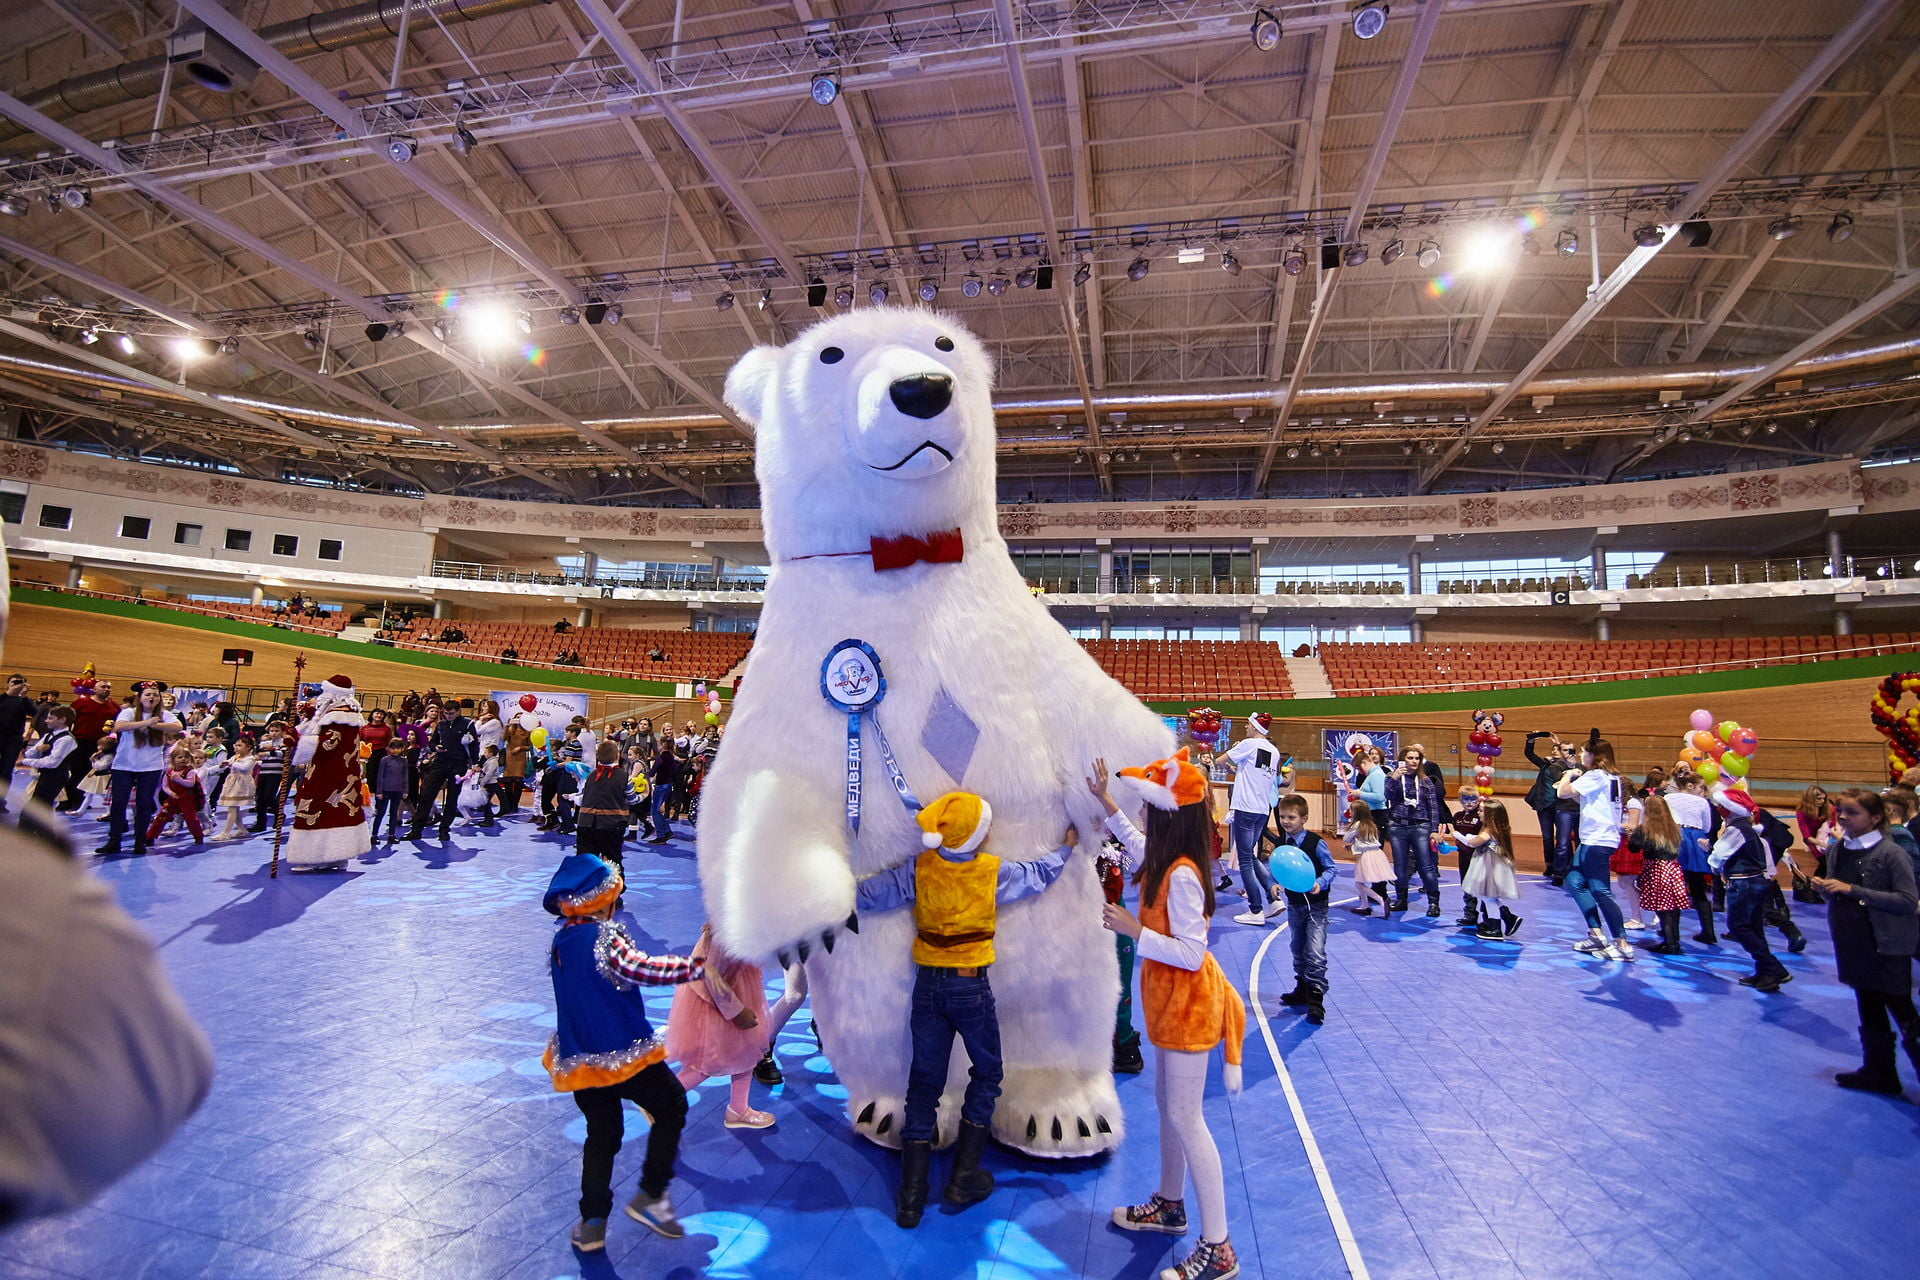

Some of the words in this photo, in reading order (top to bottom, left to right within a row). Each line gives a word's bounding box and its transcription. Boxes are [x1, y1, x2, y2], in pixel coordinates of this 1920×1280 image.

[603, 588, 611, 598] A
[1554, 592, 1566, 604] C
[847, 738, 861, 818] МЕДВЕДИ
